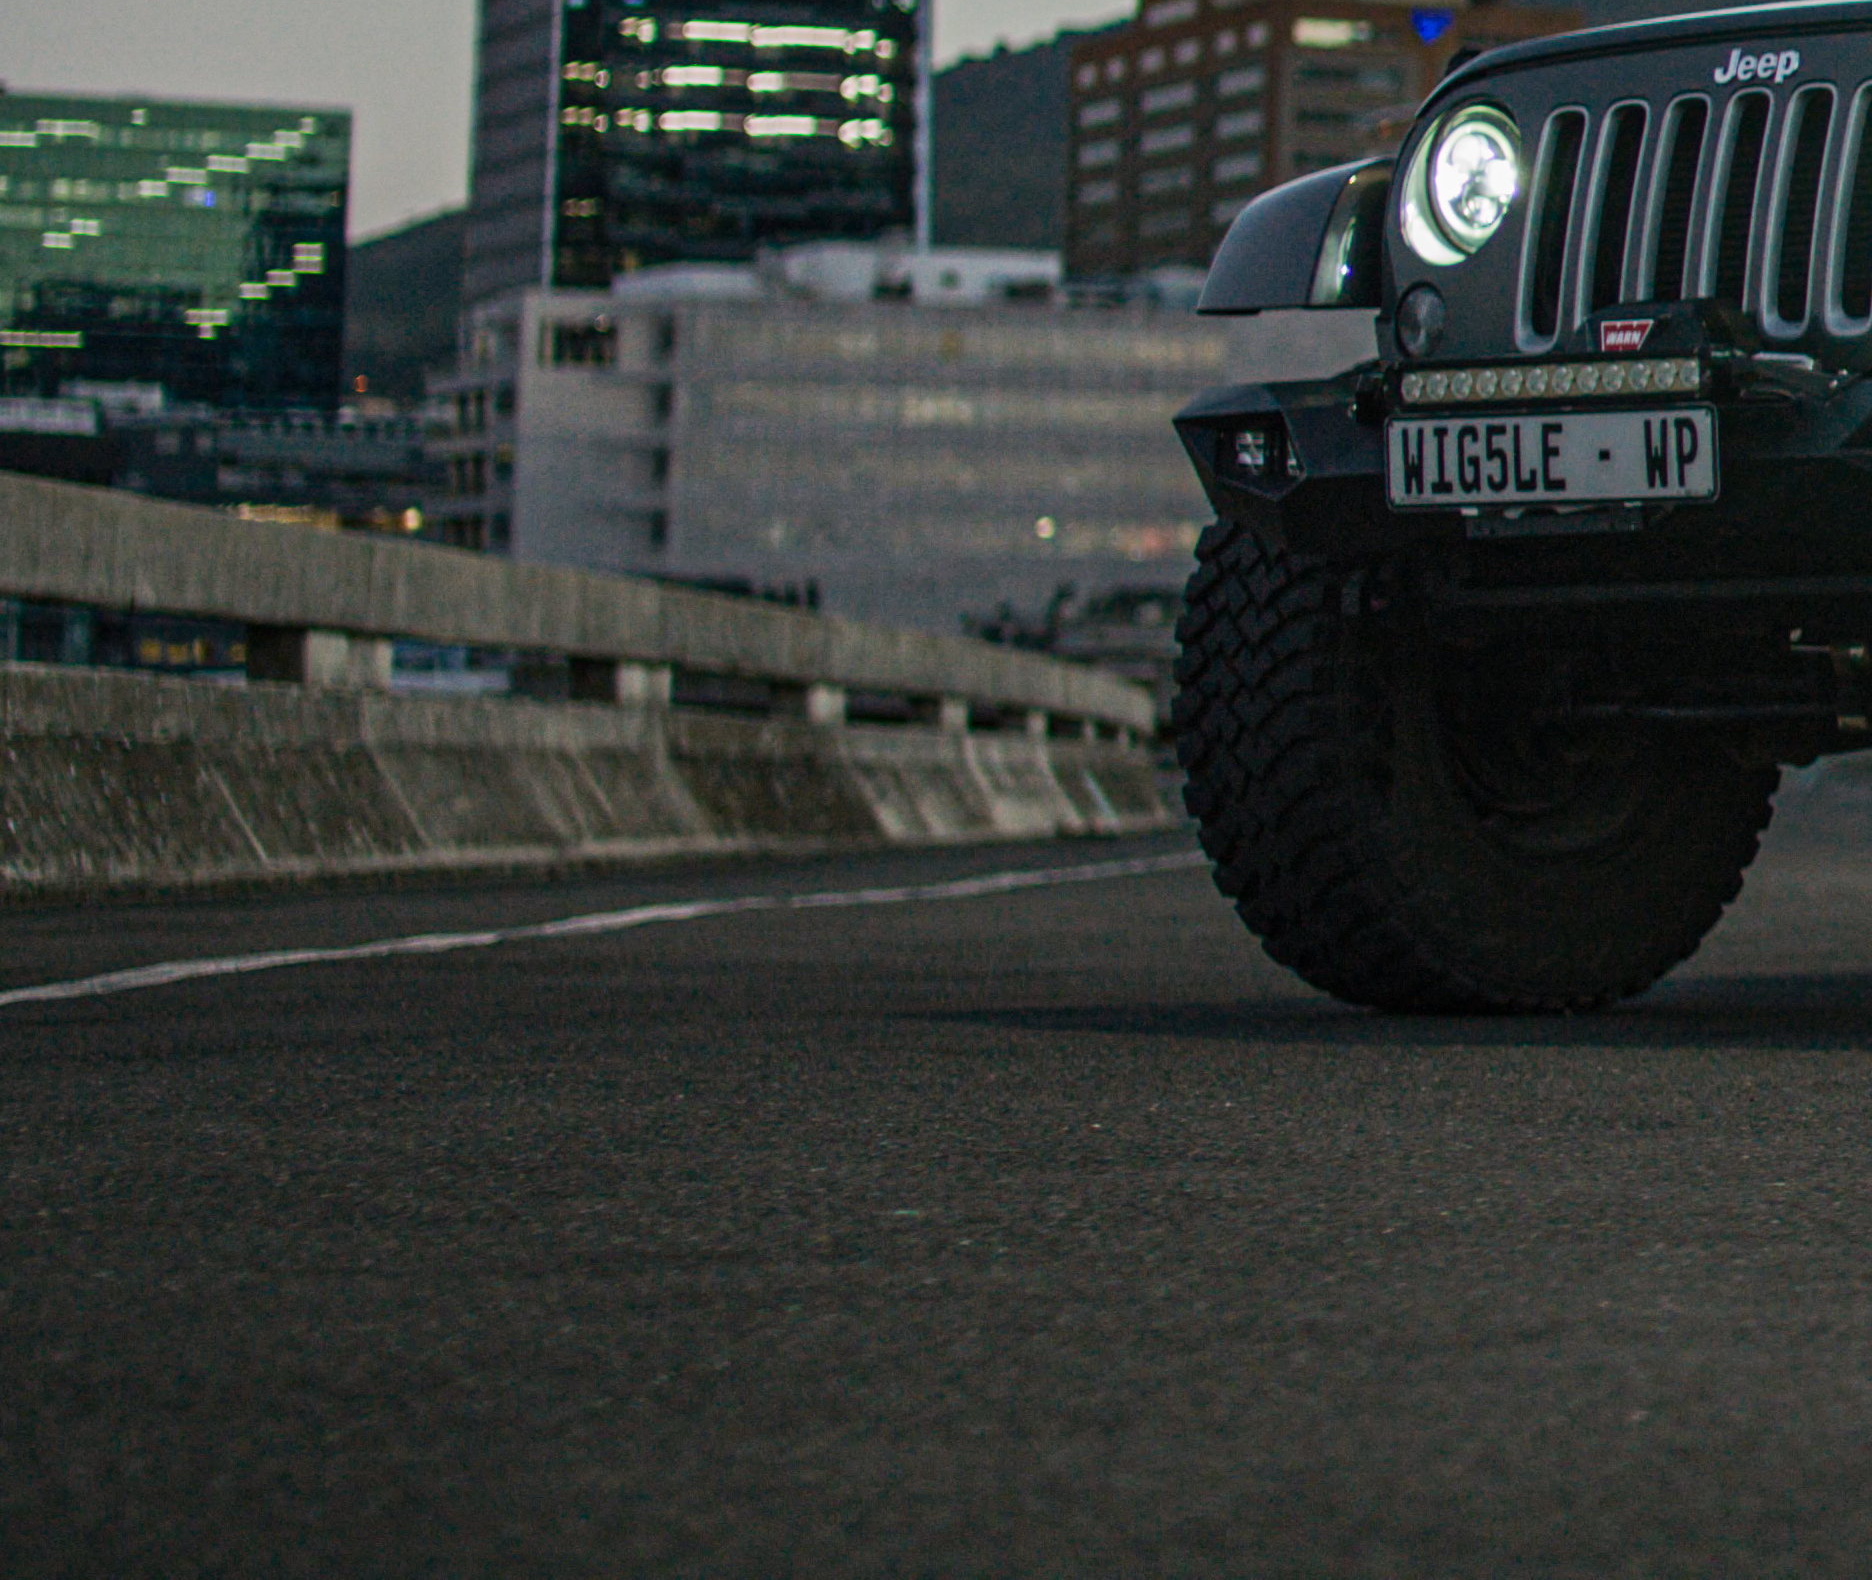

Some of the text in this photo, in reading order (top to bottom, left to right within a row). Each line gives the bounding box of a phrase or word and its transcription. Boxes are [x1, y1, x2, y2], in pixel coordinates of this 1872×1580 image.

[1714, 48, 1799, 84] Jeep
[1606, 330, 1641, 346] WARN
[1402, 423, 1567, 494] WIG5LE
[1643, 417, 1699, 489] WP
